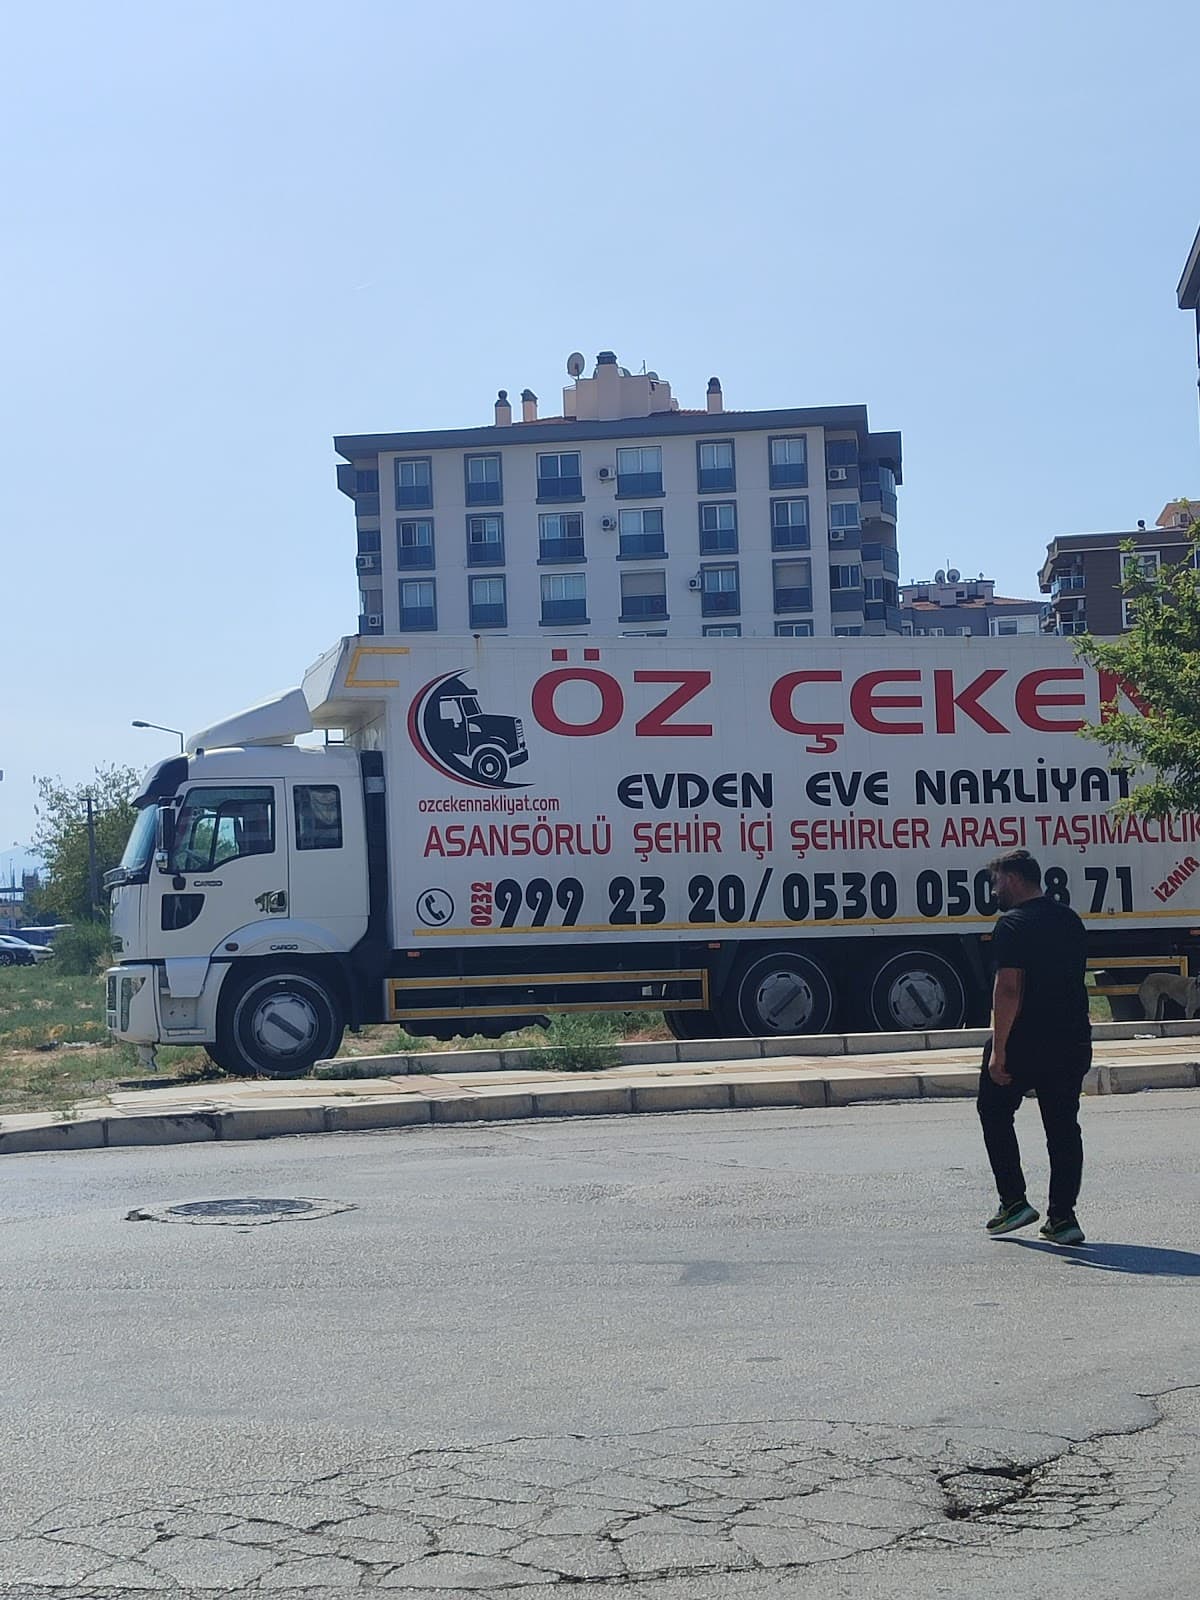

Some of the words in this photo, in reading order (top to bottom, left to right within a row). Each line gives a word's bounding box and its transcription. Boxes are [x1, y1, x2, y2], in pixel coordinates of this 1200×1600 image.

[531, 648, 714, 737] ÖZ
[418, 795, 560, 815] ozcekennakliyat.com
[617, 772, 773, 810] EVDEN
[805, 770, 889, 807] EVE
[915, 757, 1135, 805] NAKLİYAT
[423, 815, 612, 857] ASANSÖRLÜ
[633, 813, 722, 862] ŞEHİR
[740, 812, 773, 861] İÇİ
[790, 810, 930, 859] ŞEHİRLER
[941, 816, 1026, 848] ARASI
[470, 882, 493, 926] 0232
[494, 877, 585, 929] 999
[608, 876, 666, 925] 23
[1084, 866, 1134, 913] 71
[1151, 856, 1200, 903] İZMİR
